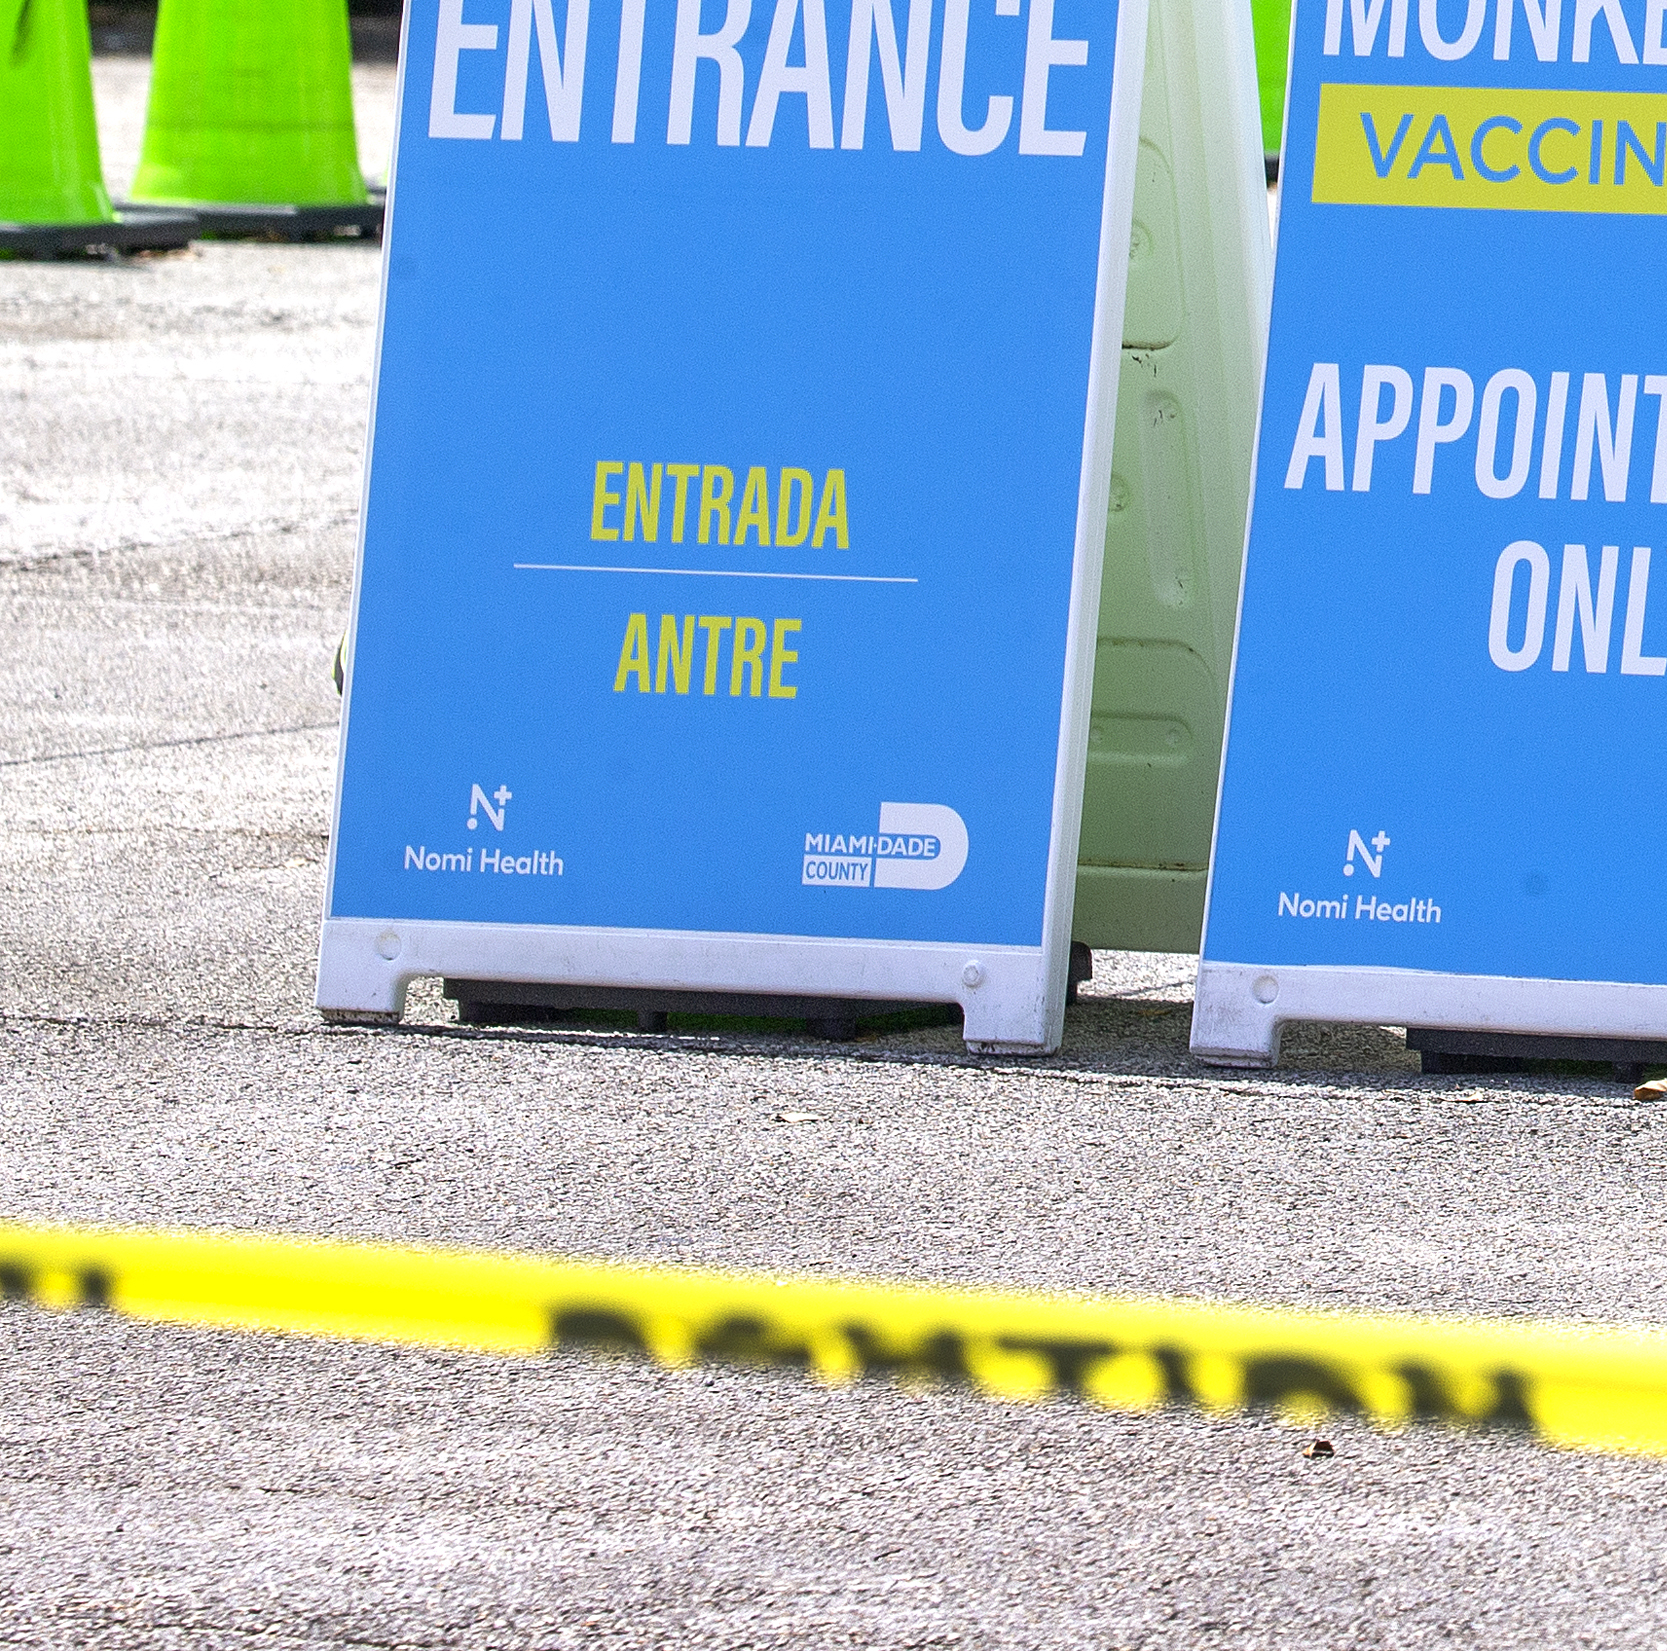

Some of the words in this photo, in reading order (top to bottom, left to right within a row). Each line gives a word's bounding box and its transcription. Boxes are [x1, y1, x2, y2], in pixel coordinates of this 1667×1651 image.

[590, 461, 849, 549] ENTRADA
[613, 612, 802, 699] ANTRE
[404, 845, 473, 872] Nomi
[480, 848, 564, 876] Health
[806, 861, 868, 881] COUNTY
[1278, 892, 1348, 919] Nomi
[1355, 895, 1441, 923] Health
